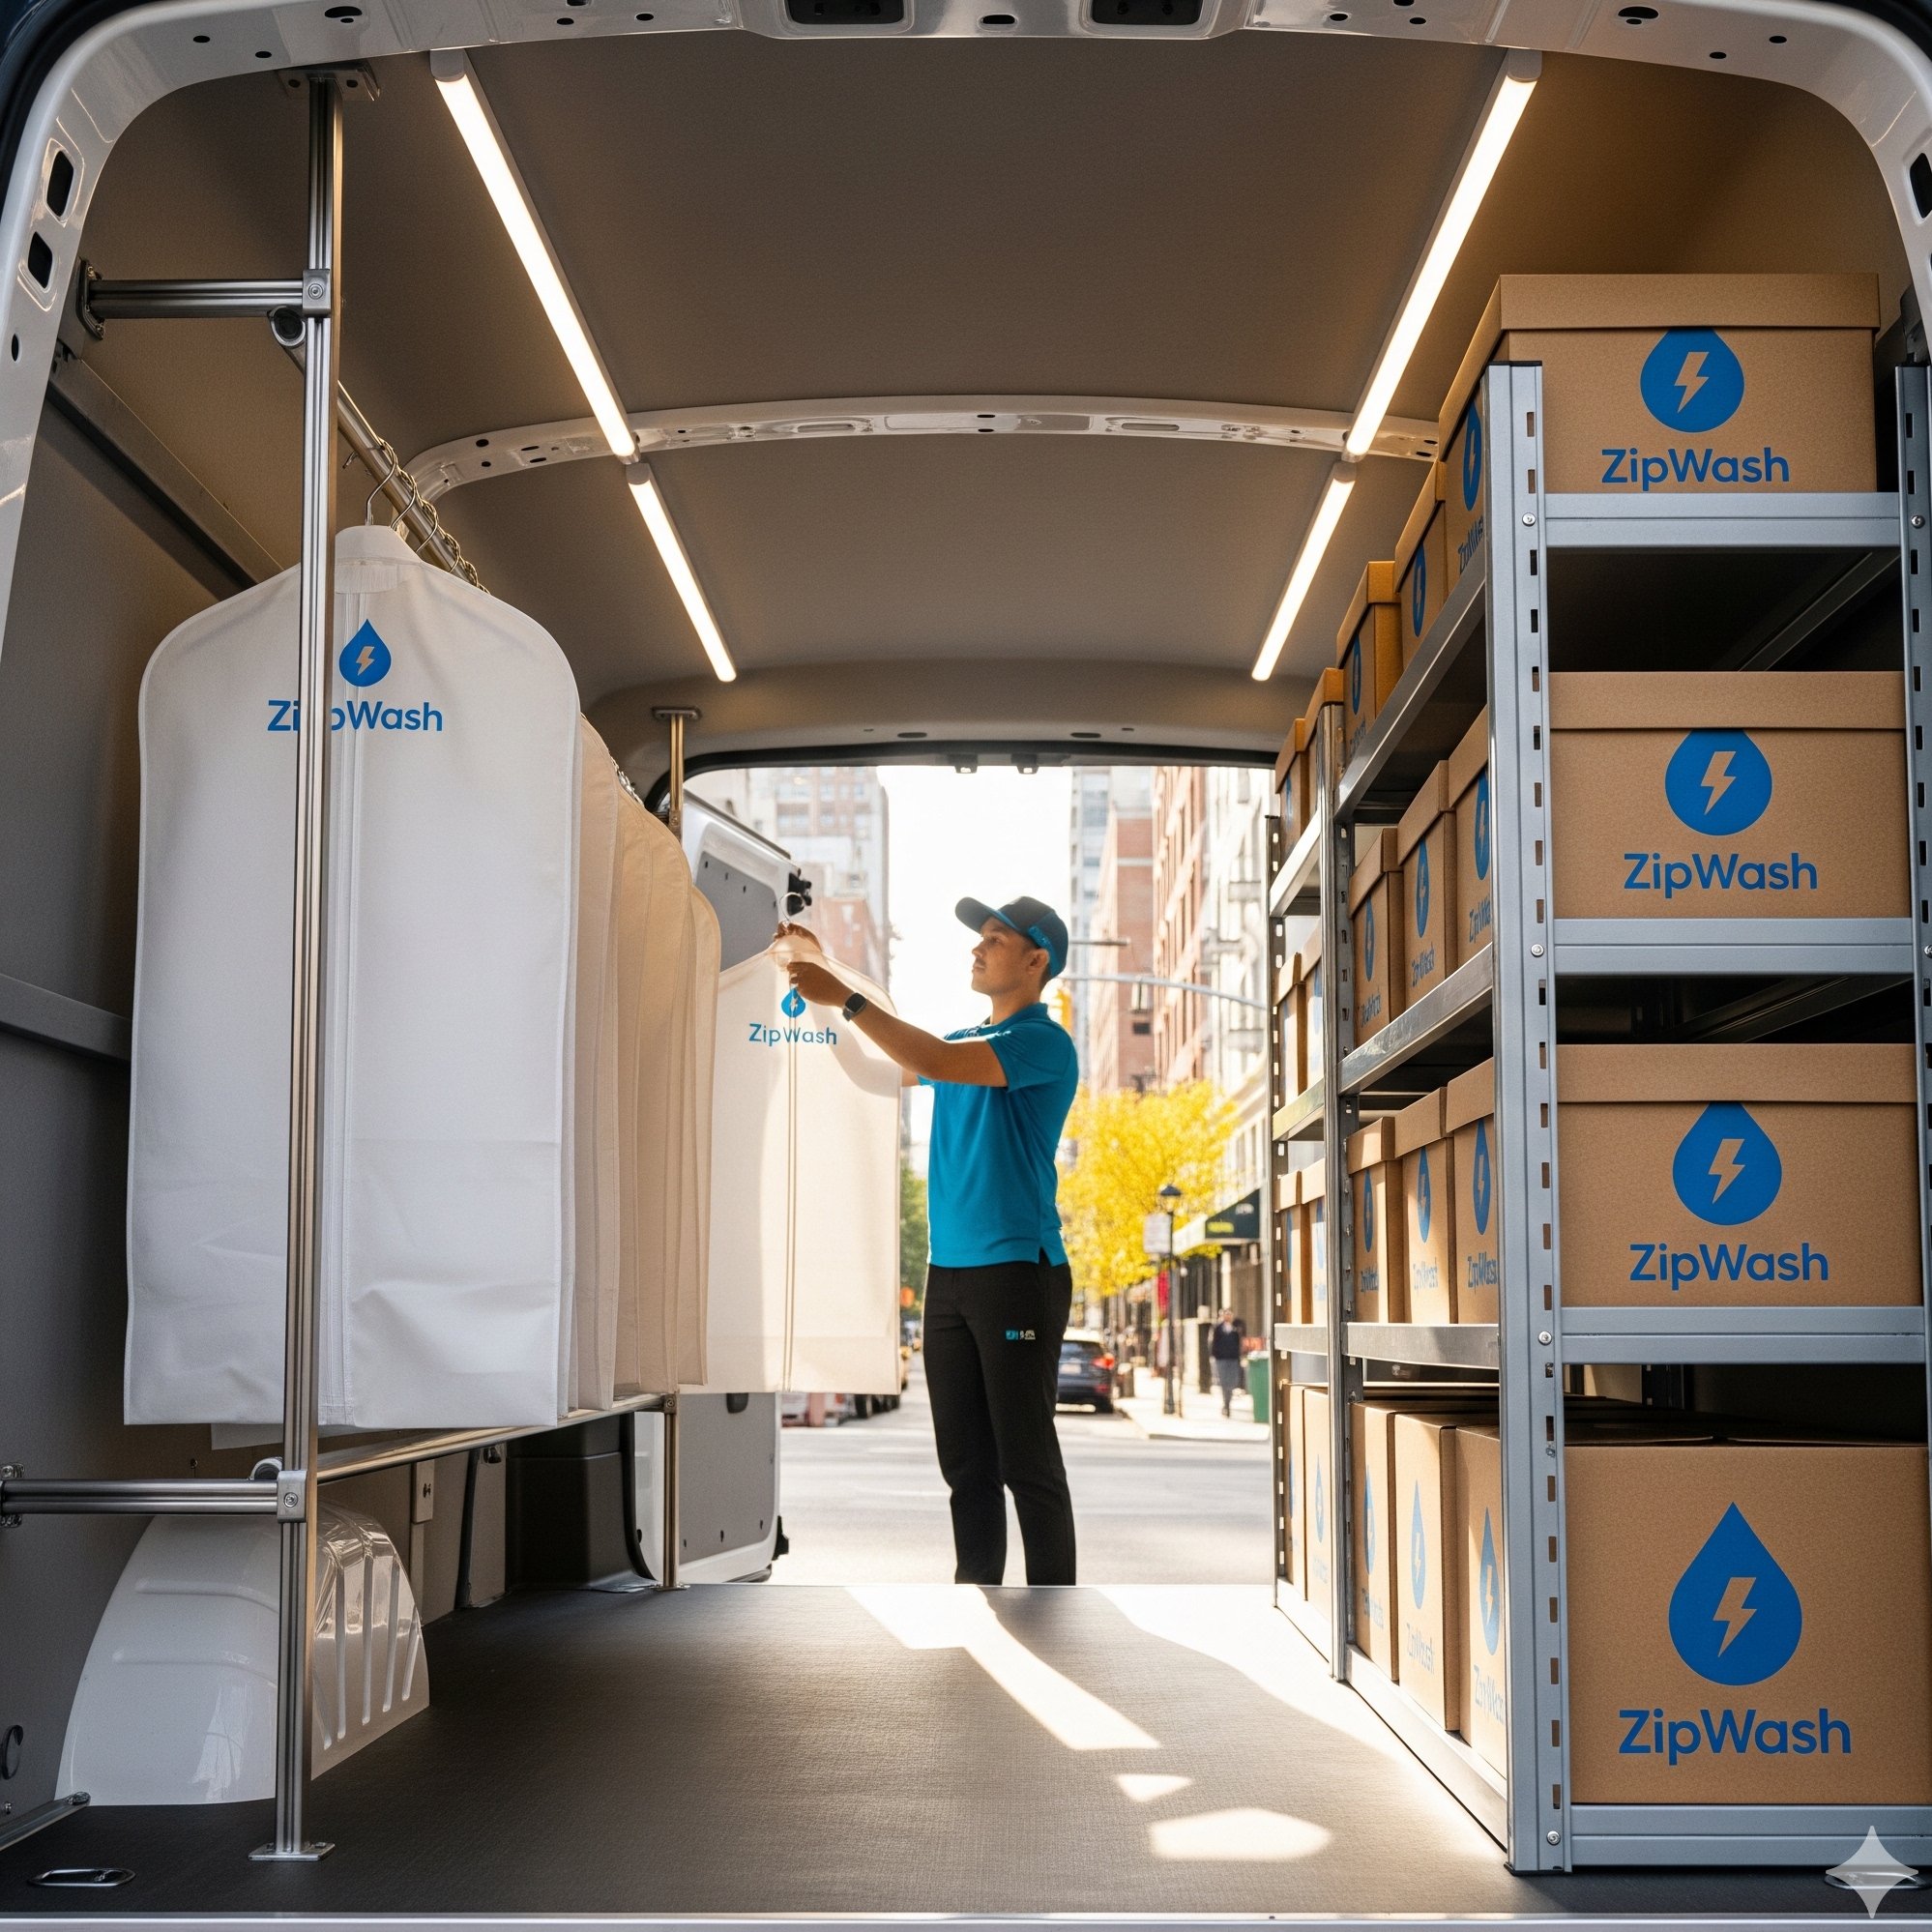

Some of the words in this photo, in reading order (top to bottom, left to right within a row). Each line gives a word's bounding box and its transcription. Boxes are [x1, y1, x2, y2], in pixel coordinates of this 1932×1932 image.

[1601, 448, 1790, 491] ZipWash
[1624, 853, 1818, 898] ZipWash
[748, 1023, 837, 1046] ZipWash
[1630, 1243, 1829, 1290] ZipWash
[1619, 1709, 1852, 1766] ZipWash
